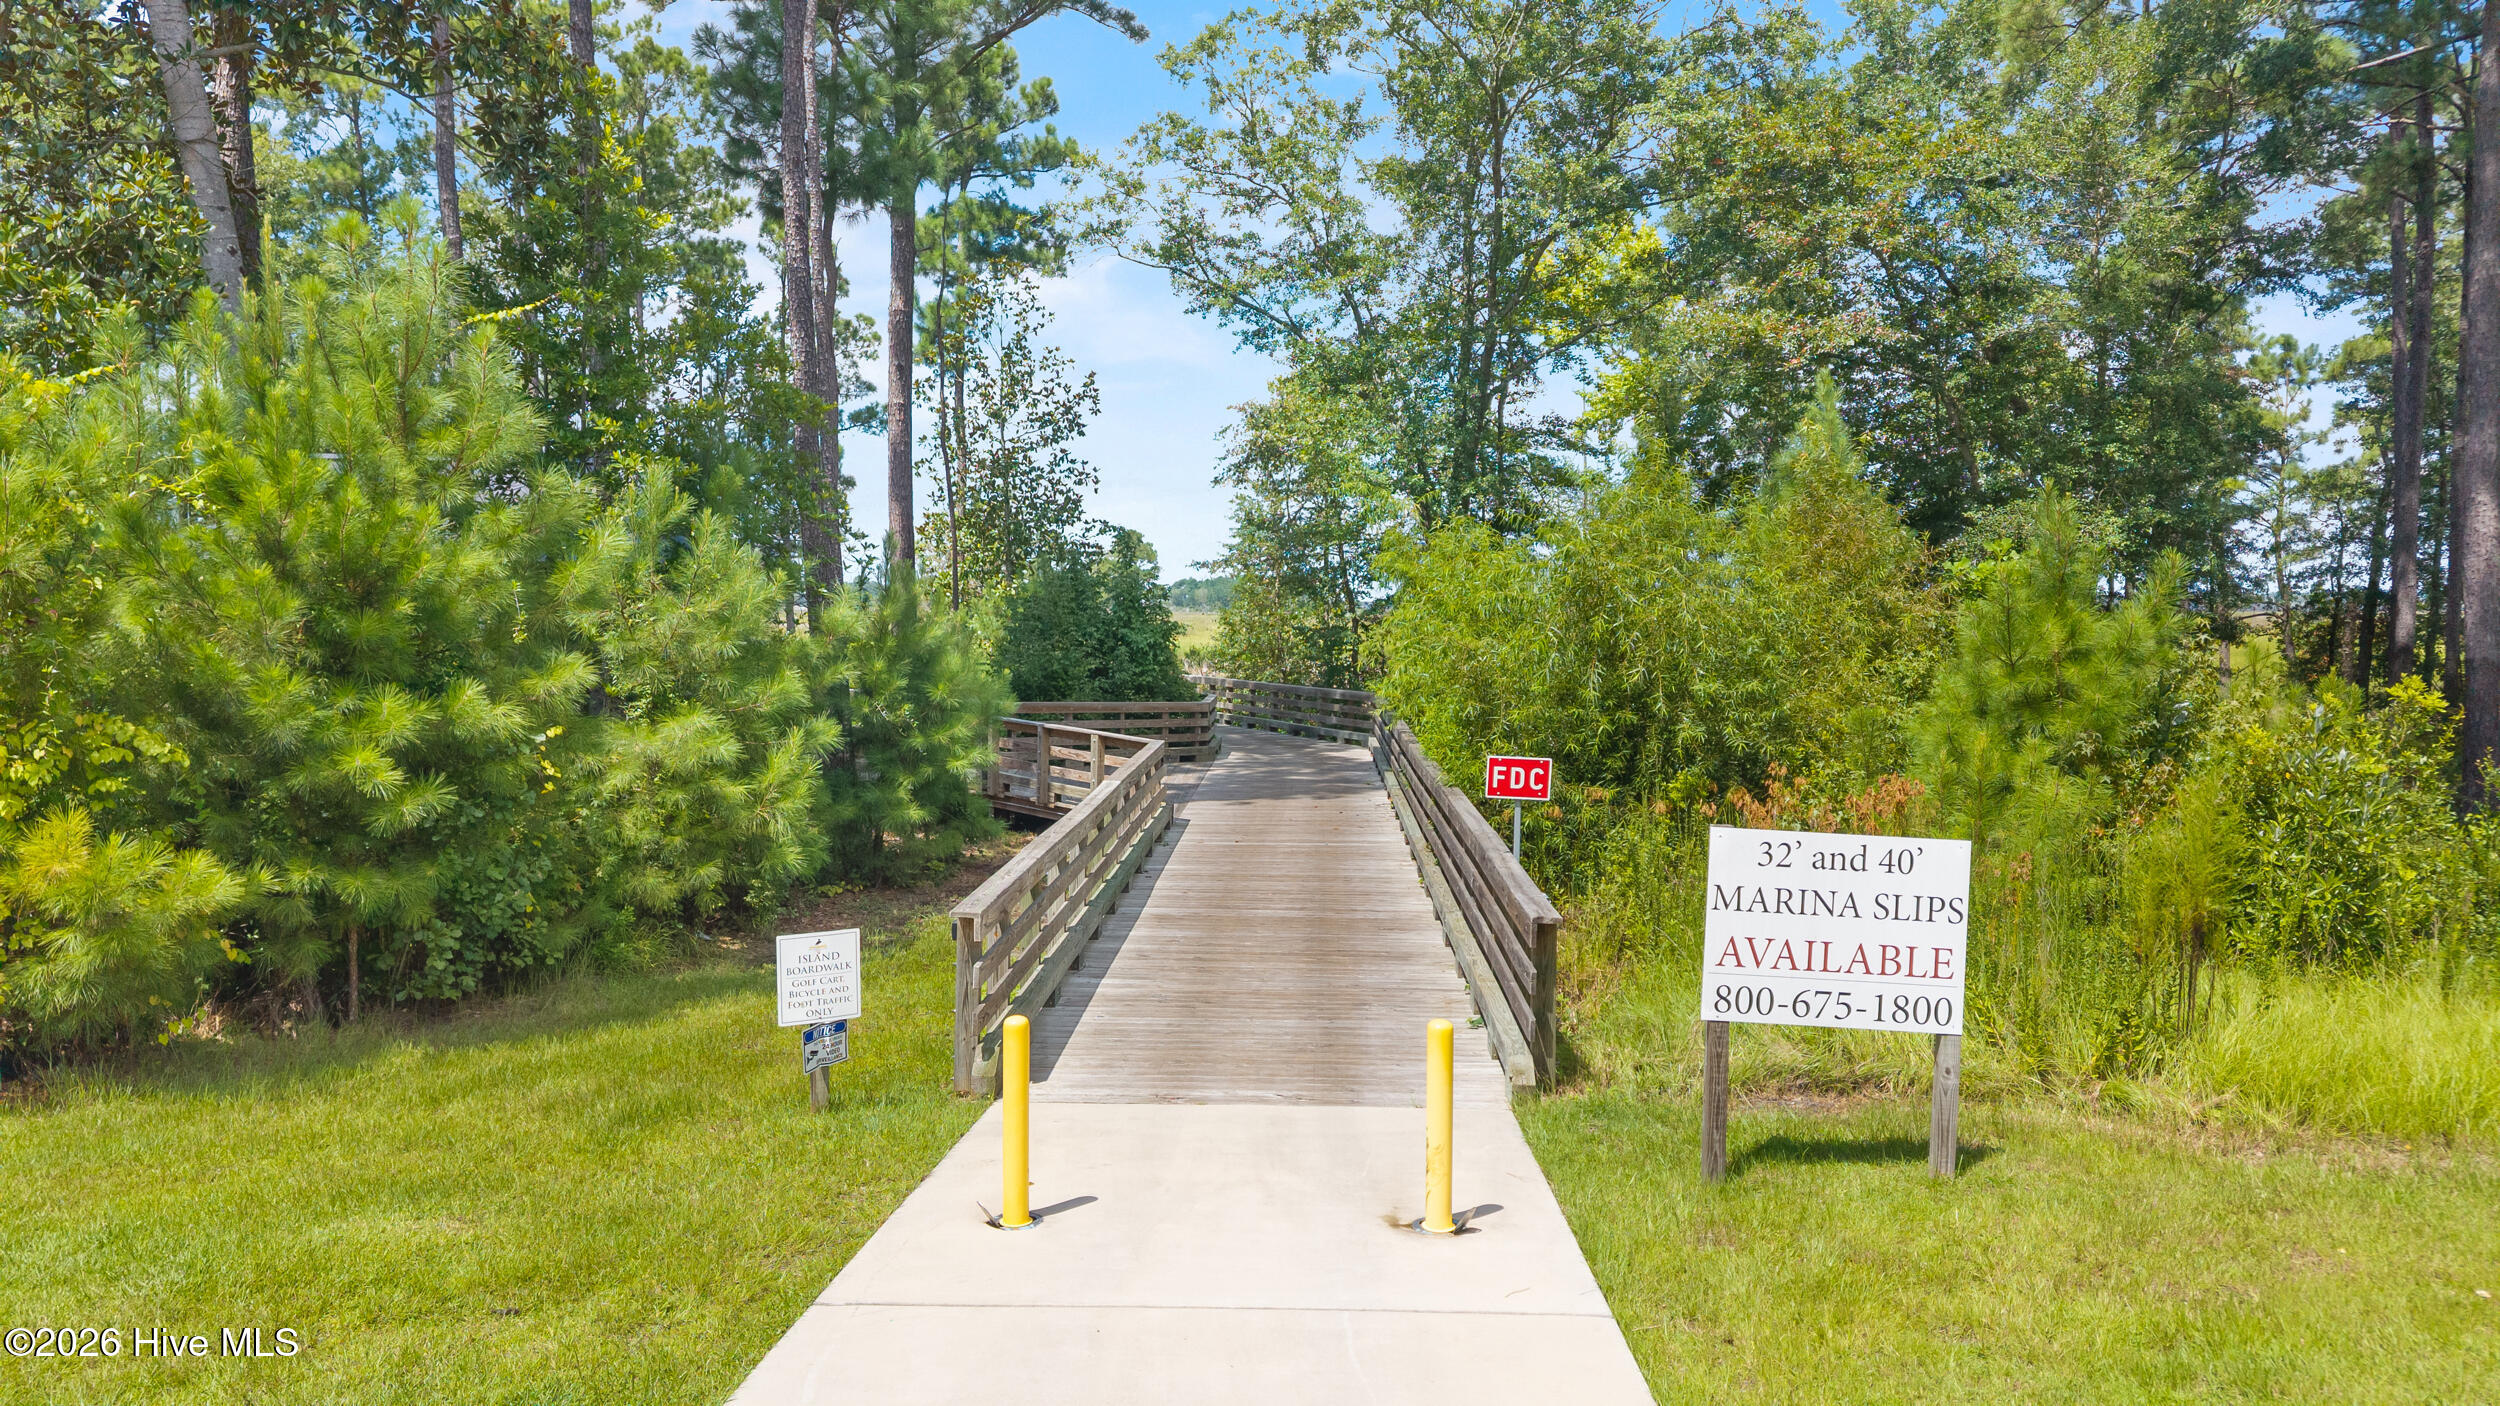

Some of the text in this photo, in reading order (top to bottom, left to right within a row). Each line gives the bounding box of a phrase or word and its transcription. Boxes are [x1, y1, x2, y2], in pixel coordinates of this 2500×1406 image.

[1492, 765, 1545, 790] FDC
[1812, 844, 1868, 872] and
[1711, 884, 1965, 925] MARINA SLIPS
[798, 951, 840, 964] ISLAND
[1714, 935, 1955, 980] AVAILABLE
[786, 961, 852, 976] BOARDWALK
[791, 978, 818, 988] GOLF
[789, 985, 849, 999] BICYCLE AND
[788, 995, 853, 1009] FOOT TRAFFIC
[1713, 984, 1954, 1027] 800-675-1800
[805, 1007, 833, 1018] ONLY
